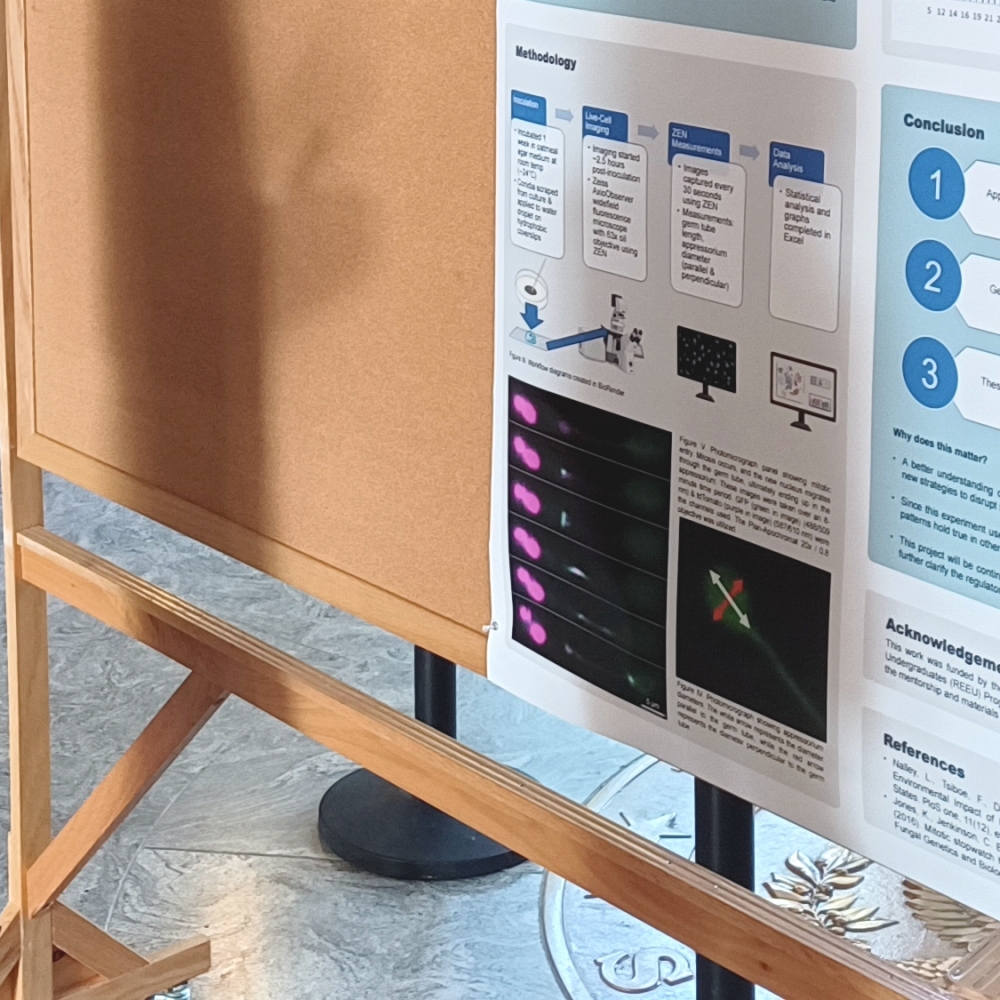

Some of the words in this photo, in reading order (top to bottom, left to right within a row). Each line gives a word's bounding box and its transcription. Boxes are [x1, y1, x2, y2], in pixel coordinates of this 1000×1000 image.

[937, 8, 945, 16] 12
[961, 11, 969, 19] 16
[973, 12, 982, 20] 19
[985, 14, 993, 22] 21
[515, 45, 577, 71] Methodology
[584, 111, 613, 124] Live-Cell
[672, 128, 688, 139] ZEN
[903, 113, 985, 140] Conclusion
[672, 139, 723, 156] Measurements
[773, 148, 791, 160] Data
[772, 159, 804, 173] Analysis
[930, 169, 942, 200] 1
[924, 260, 942, 293] 2
[921, 357, 938, 390] 3
[893, 427, 912, 442] Why
[914, 435, 934, 447] does
[937, 441, 952, 453] this
[955, 448, 988, 464] matter?
[902, 458, 908, 466] A
[911, 460, 934, 474] better
[937, 470, 993, 497] understanding
[902, 471, 918, 482] new
[920, 478, 958, 496] strategies
[960, 491, 968, 499] to
[970, 494, 997, 510] disrupt
[900, 511, 931, 528] patterns
[933, 521, 950, 534] hold
[952, 528, 968, 540] true
[970, 534, 977, 544] in
[901, 496, 922, 511] Since
[925, 505, 939, 517] this
[941, 512, 986, 533] experiment
[899, 535, 916, 549] This
[918, 544, 944, 558] project
[948, 555, 960, 565] will
[963, 559, 973, 570] be
[899, 549, 924, 565] further
[925, 560, 948, 576] clarify
[951, 569, 963, 580] the
[885, 652, 947, 684] Undergraduates
[950, 679, 981, 699] (REEU)
[886, 638, 902, 652] This
[905, 648, 923, 660] work
[927, 657, 943, 668] was
[947, 663, 974, 681] funded
[977, 676, 987, 688] by
[885, 665, 897, 676] the
[899, 671, 942, 695] mentorship
[944, 691, 959, 702] and
[961, 697, 999, 718] materials
[884, 733, 965, 778] References
